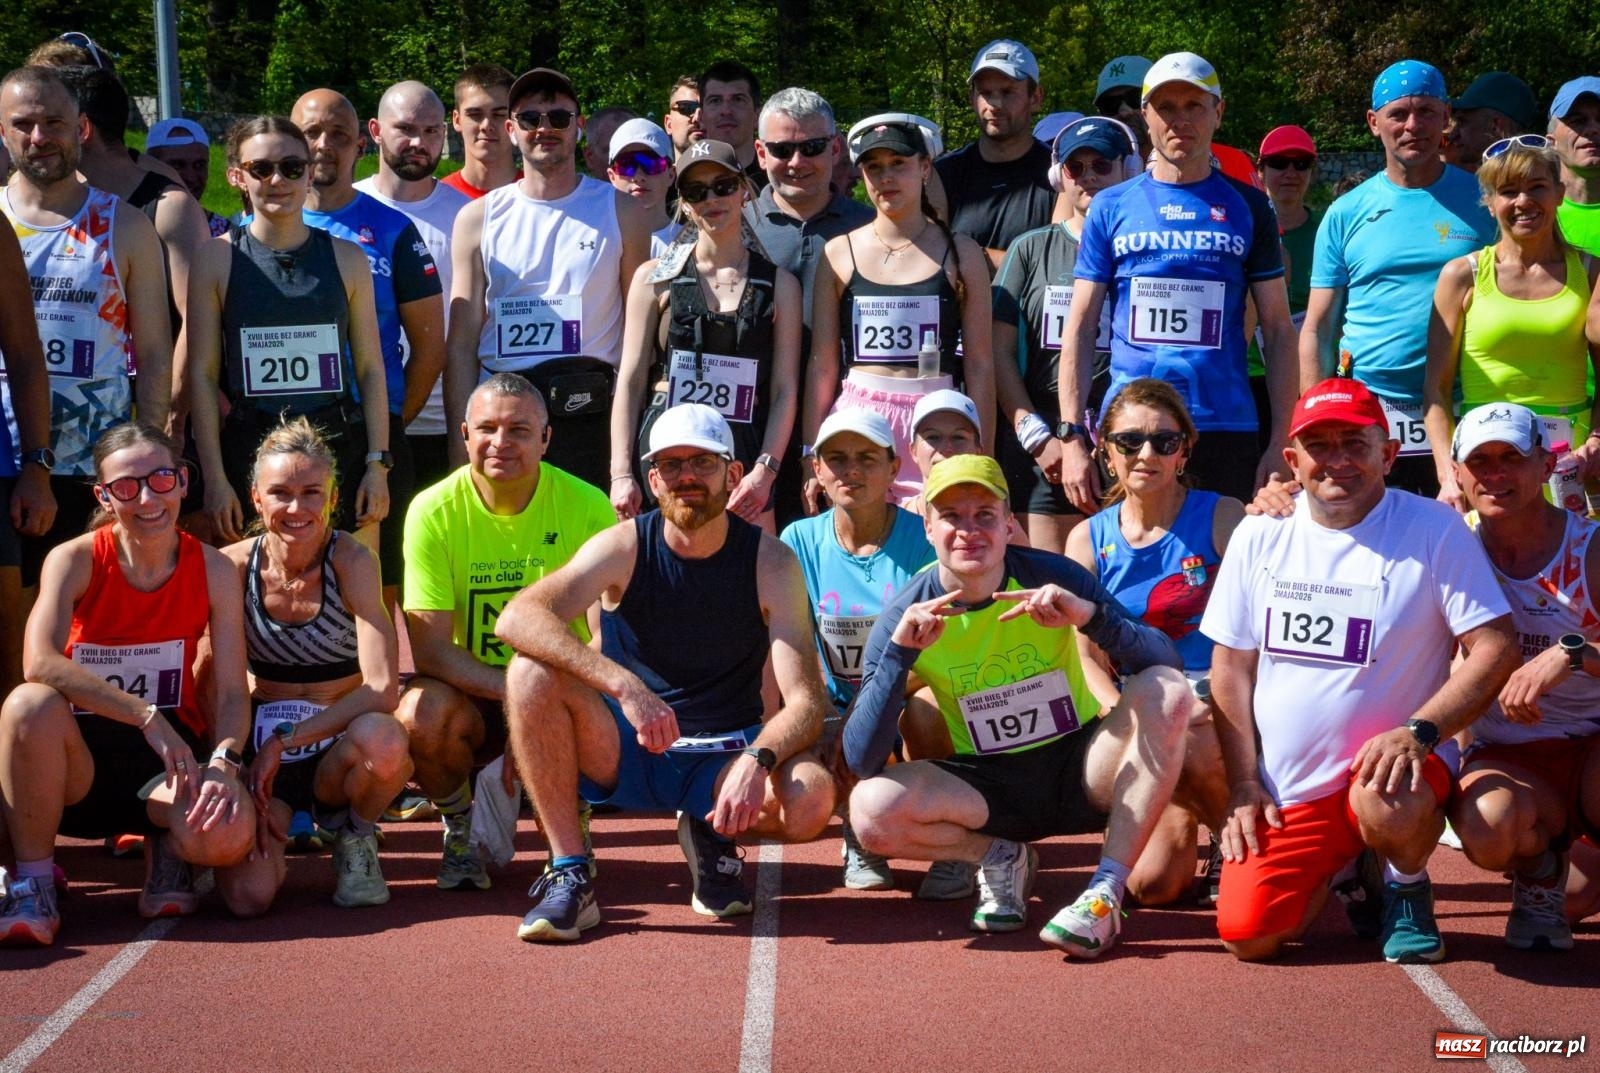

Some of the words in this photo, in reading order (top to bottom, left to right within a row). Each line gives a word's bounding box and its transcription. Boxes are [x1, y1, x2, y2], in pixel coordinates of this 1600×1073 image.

[1113, 231, 1245, 258] RUNNERS
[1193, 254, 1220, 263] TEAM
[48, 277, 73, 288] BIEG
[1153, 283, 1168, 291] BIEG
[1168, 284, 1181, 292] BEZ
[1181, 285, 1204, 293] GRANIC
[1136, 290, 1171, 298] 3MAJA2026
[36, 313, 49, 321] BEZ
[50, 313, 75, 322] GRANIC
[501, 308, 532, 316] 3MAJA2026
[1149, 307, 1188, 334] 115
[248, 333, 263, 341] XVIII
[264, 332, 279, 340] BIEG
[281, 331, 292, 339] BEZ
[293, 330, 317, 339] GRANIC
[508, 322, 555, 348] 227
[864, 325, 913, 350] 233
[248, 340, 285, 349] 3MAJA2026
[677, 362, 711, 373] 3MAJA26
[707, 358, 719, 366] BEZ
[719, 359, 741, 368] GRANIC
[260, 356, 309, 383] 210
[680, 380, 730, 408] 228
[1544, 422, 1557, 430] NIC
[470, 561, 496, 571] new
[500, 558, 545, 570] balance
[470, 574, 491, 584] run
[495, 571, 523, 583] club
[1275, 581, 1291, 589] XVIII
[1292, 582, 1308, 591] BIEG
[1309, 584, 1323, 593] BEZ
[1324, 586, 1353, 597] GRANIC
[1273, 590, 1312, 601] 3MAJA2026
[836, 620, 851, 628] BIEG
[852, 620, 864, 628] BEZ
[1282, 611, 1334, 646] 132
[80, 648, 98, 656] XVIII
[100, 648, 117, 656] BIEG
[118, 648, 132, 656] BEZ
[133, 647, 161, 656] GRANIC
[836, 645, 863, 669] 17
[80, 657, 122, 665] 3MAJA2026
[967, 696, 984, 706] XVIII
[984, 692, 1001, 702] BIEG
[1002, 689, 1015, 699] BEZ
[1016, 681, 1043, 695] GRANIC
[299, 705, 310, 714] BEZ
[968, 700, 1009, 713] 3MAJA2026
[263, 712, 302, 720] 3MAJA2026
[986, 708, 1038, 742] 197
